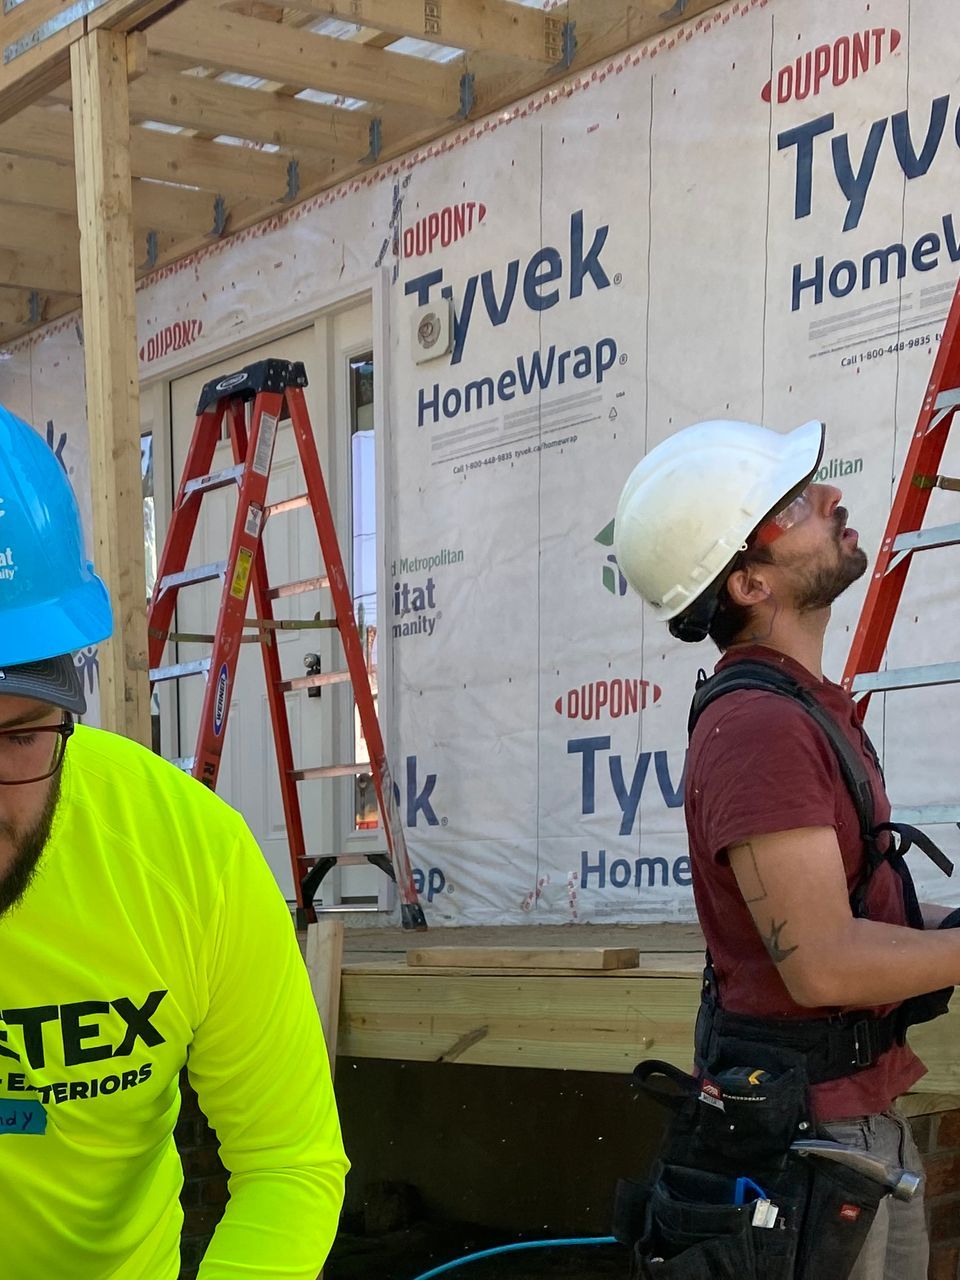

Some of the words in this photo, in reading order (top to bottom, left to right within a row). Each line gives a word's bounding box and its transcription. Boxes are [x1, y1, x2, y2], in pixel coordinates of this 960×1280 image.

[778, 27, 886, 104] DUPONT
[778, 94, 960, 232] Tyv
[403, 201, 476, 259] DUPONT
[792, 213, 960, 313] Home
[404, 209, 611, 366] Tyvek
[841, 355, 857, 367] Call
[859, 334, 931, 362] 1-800-448-9835
[418, 337, 618, 428] HomeWrap
[453, 464, 464, 475] Call
[813, 457, 863, 482] olitan
[399, 549, 464, 576] Metropolitan
[394, 577, 436, 616] itat
[392, 614, 436, 638] manity
[216, 677, 228, 722] WERNER
[567, 678, 650, 721] DUPONT
[567, 735, 688, 836] Tyv
[581, 849, 693, 889] Home
